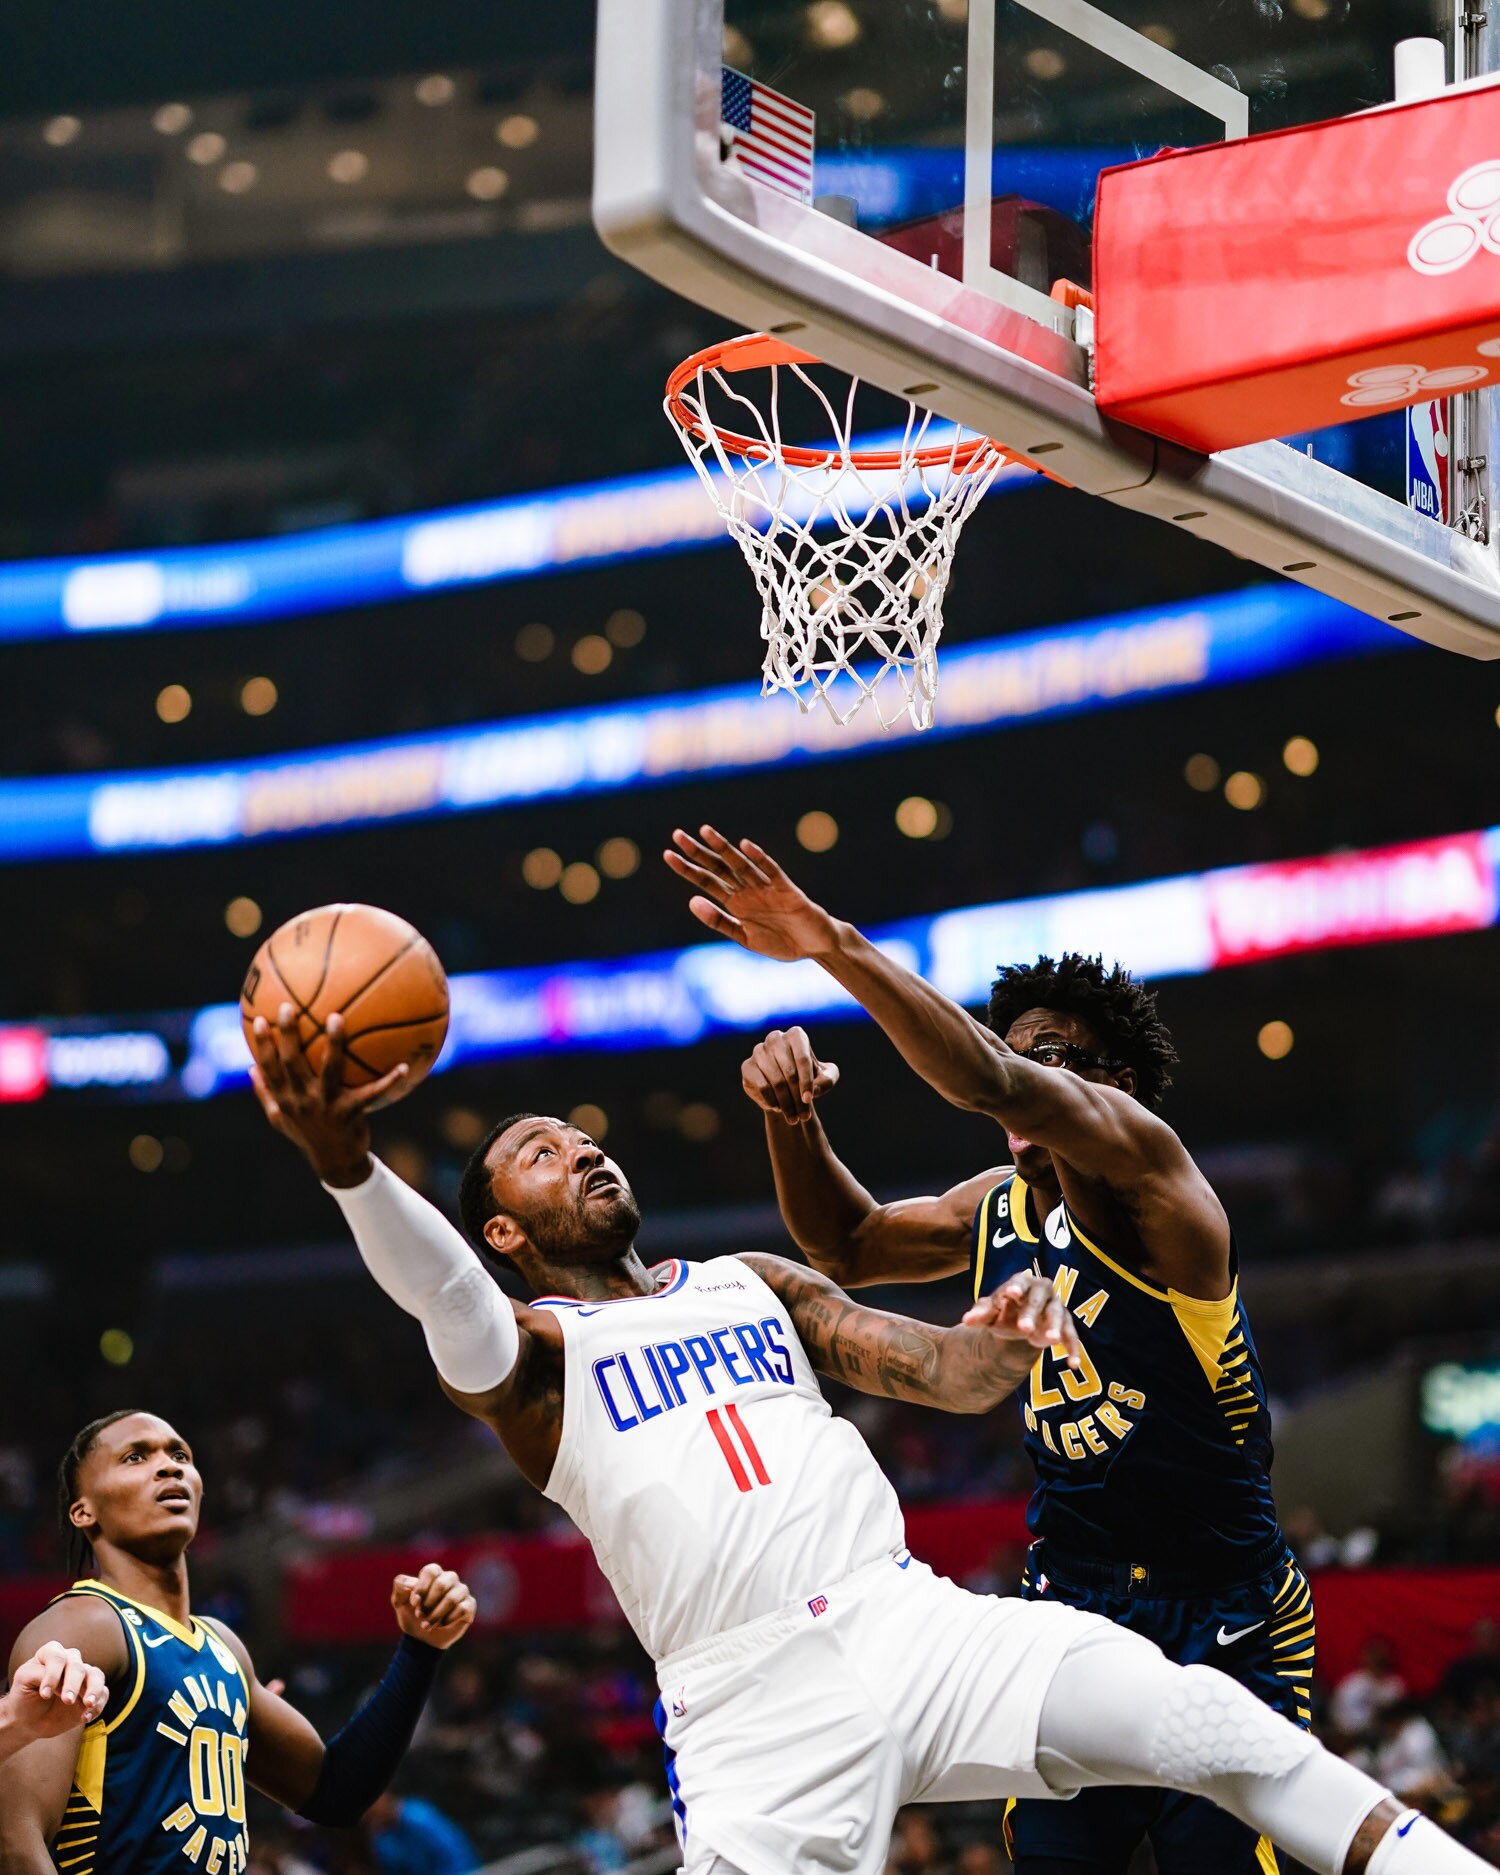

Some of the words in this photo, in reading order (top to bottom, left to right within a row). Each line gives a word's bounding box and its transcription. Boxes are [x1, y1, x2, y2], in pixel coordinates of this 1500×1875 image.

[1413, 478, 1434, 513] NBA
[997, 1192, 1009, 1218] 6
[694, 1280, 747, 1293] honey
[591, 1317, 795, 1432] CLIPPERS
[705, 1403, 773, 1493] 11
[1024, 1381, 1146, 1460] PACERS
[189, 1725, 246, 1824] 00
[161, 1802, 249, 1875] PACER
